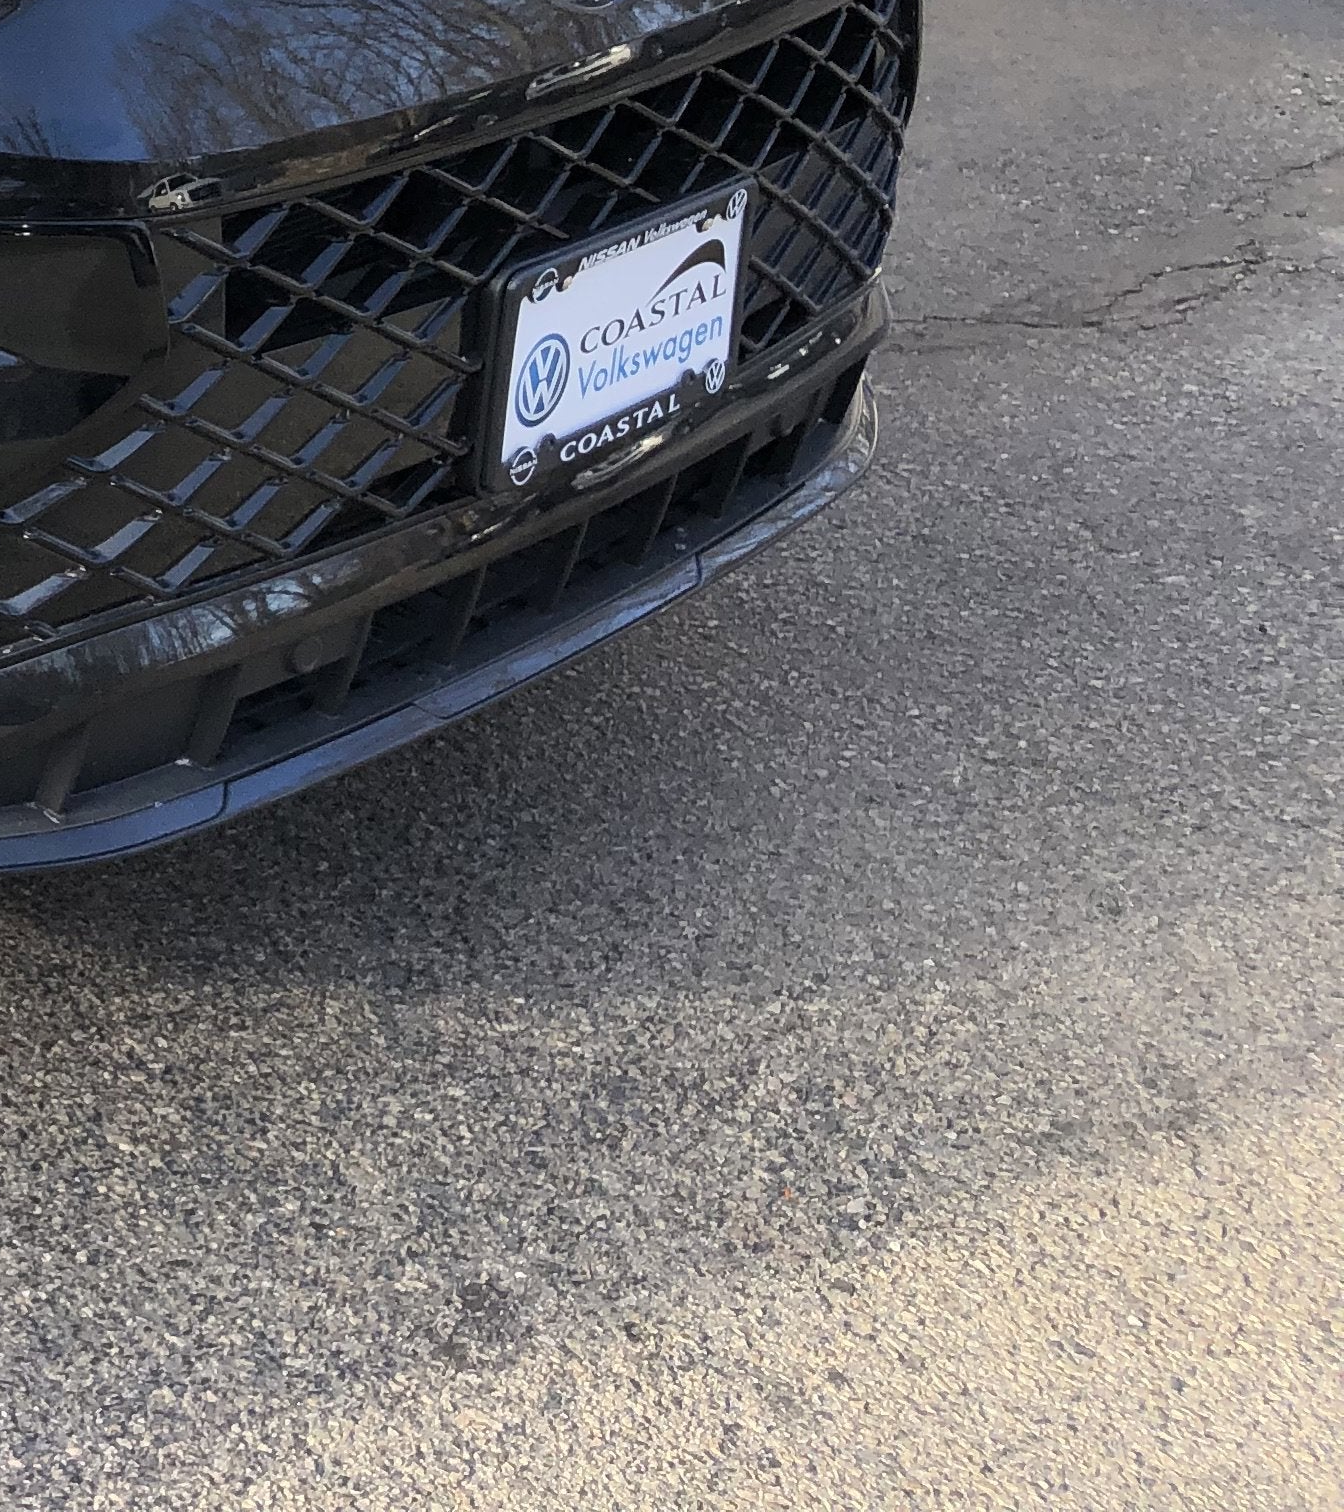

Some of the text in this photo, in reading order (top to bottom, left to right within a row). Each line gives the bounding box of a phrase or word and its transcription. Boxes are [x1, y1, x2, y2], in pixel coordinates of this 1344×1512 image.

[580, 274, 727, 354] COASTAL
[578, 315, 723, 400] Volkswagen
[560, 393, 681, 462] COASTAL
